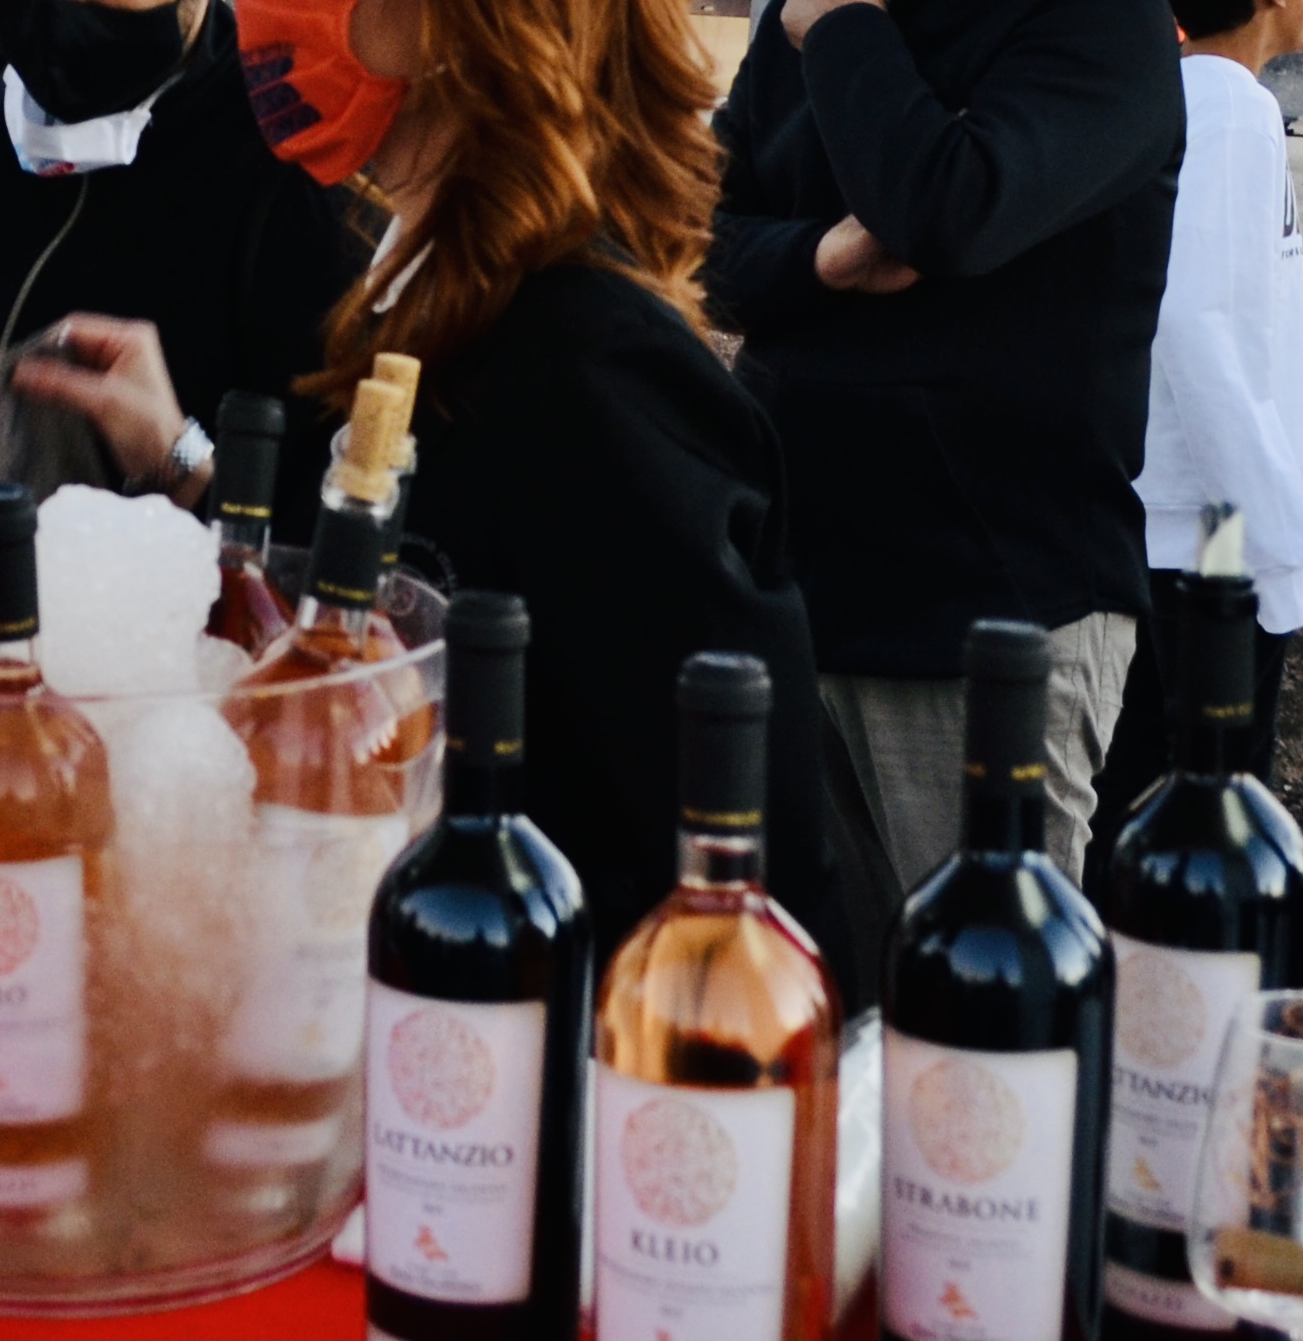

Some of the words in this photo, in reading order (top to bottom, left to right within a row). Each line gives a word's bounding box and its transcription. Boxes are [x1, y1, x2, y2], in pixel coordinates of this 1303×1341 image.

[1113, 1066, 1213, 1104] TTANZI
[373, 1122, 515, 1168] LATTANZIO
[894, 1177, 1040, 1222] STRABONE
[630, 1229, 720, 1267] KLEIO
